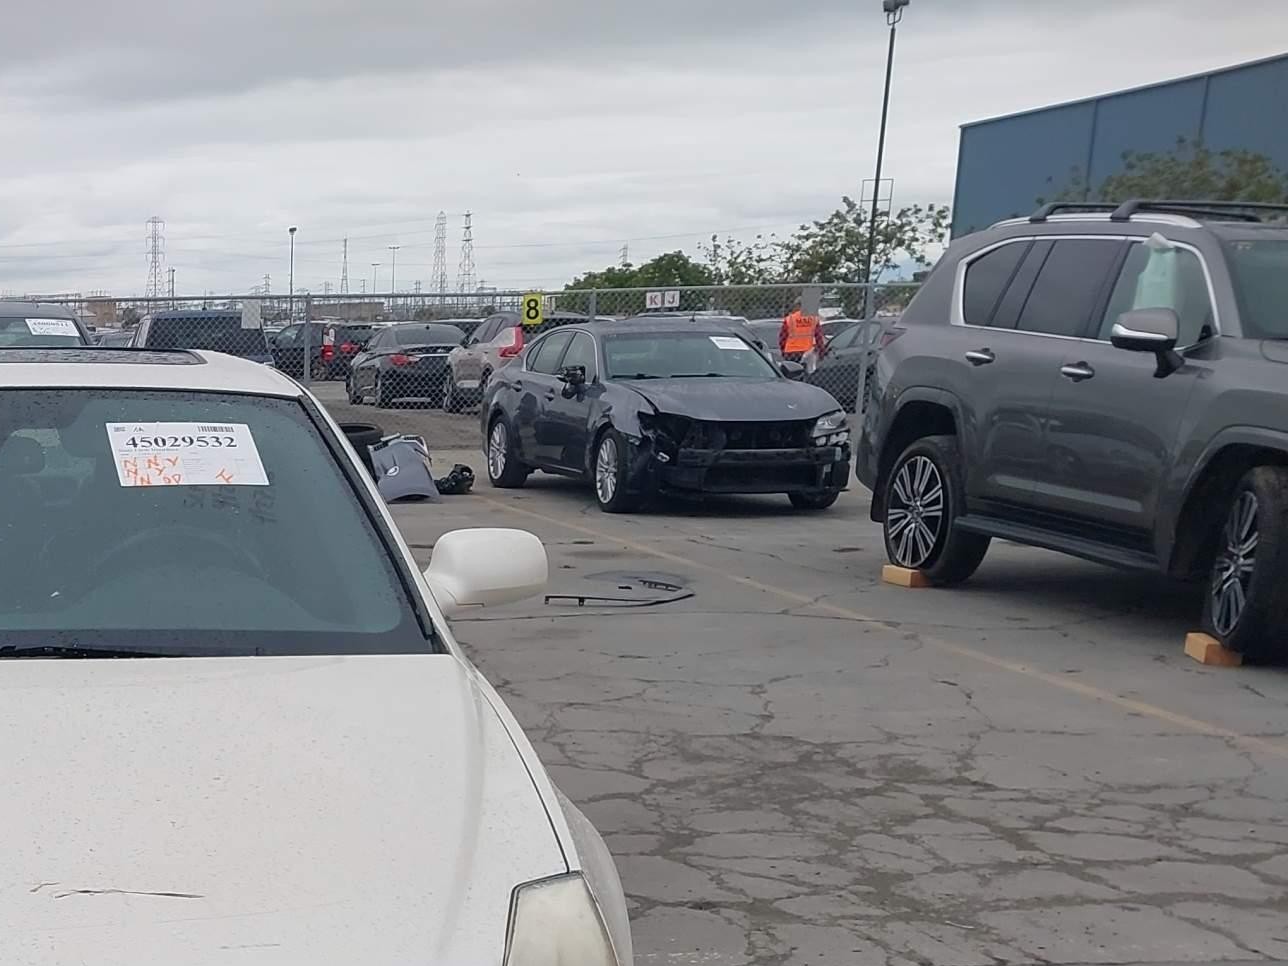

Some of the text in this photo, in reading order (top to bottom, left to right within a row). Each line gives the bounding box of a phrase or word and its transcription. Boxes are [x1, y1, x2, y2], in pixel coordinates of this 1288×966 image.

[649, 295, 659, 306] K
[525, 298, 540, 320] 8
[125, 436, 238, 448] 45029532
